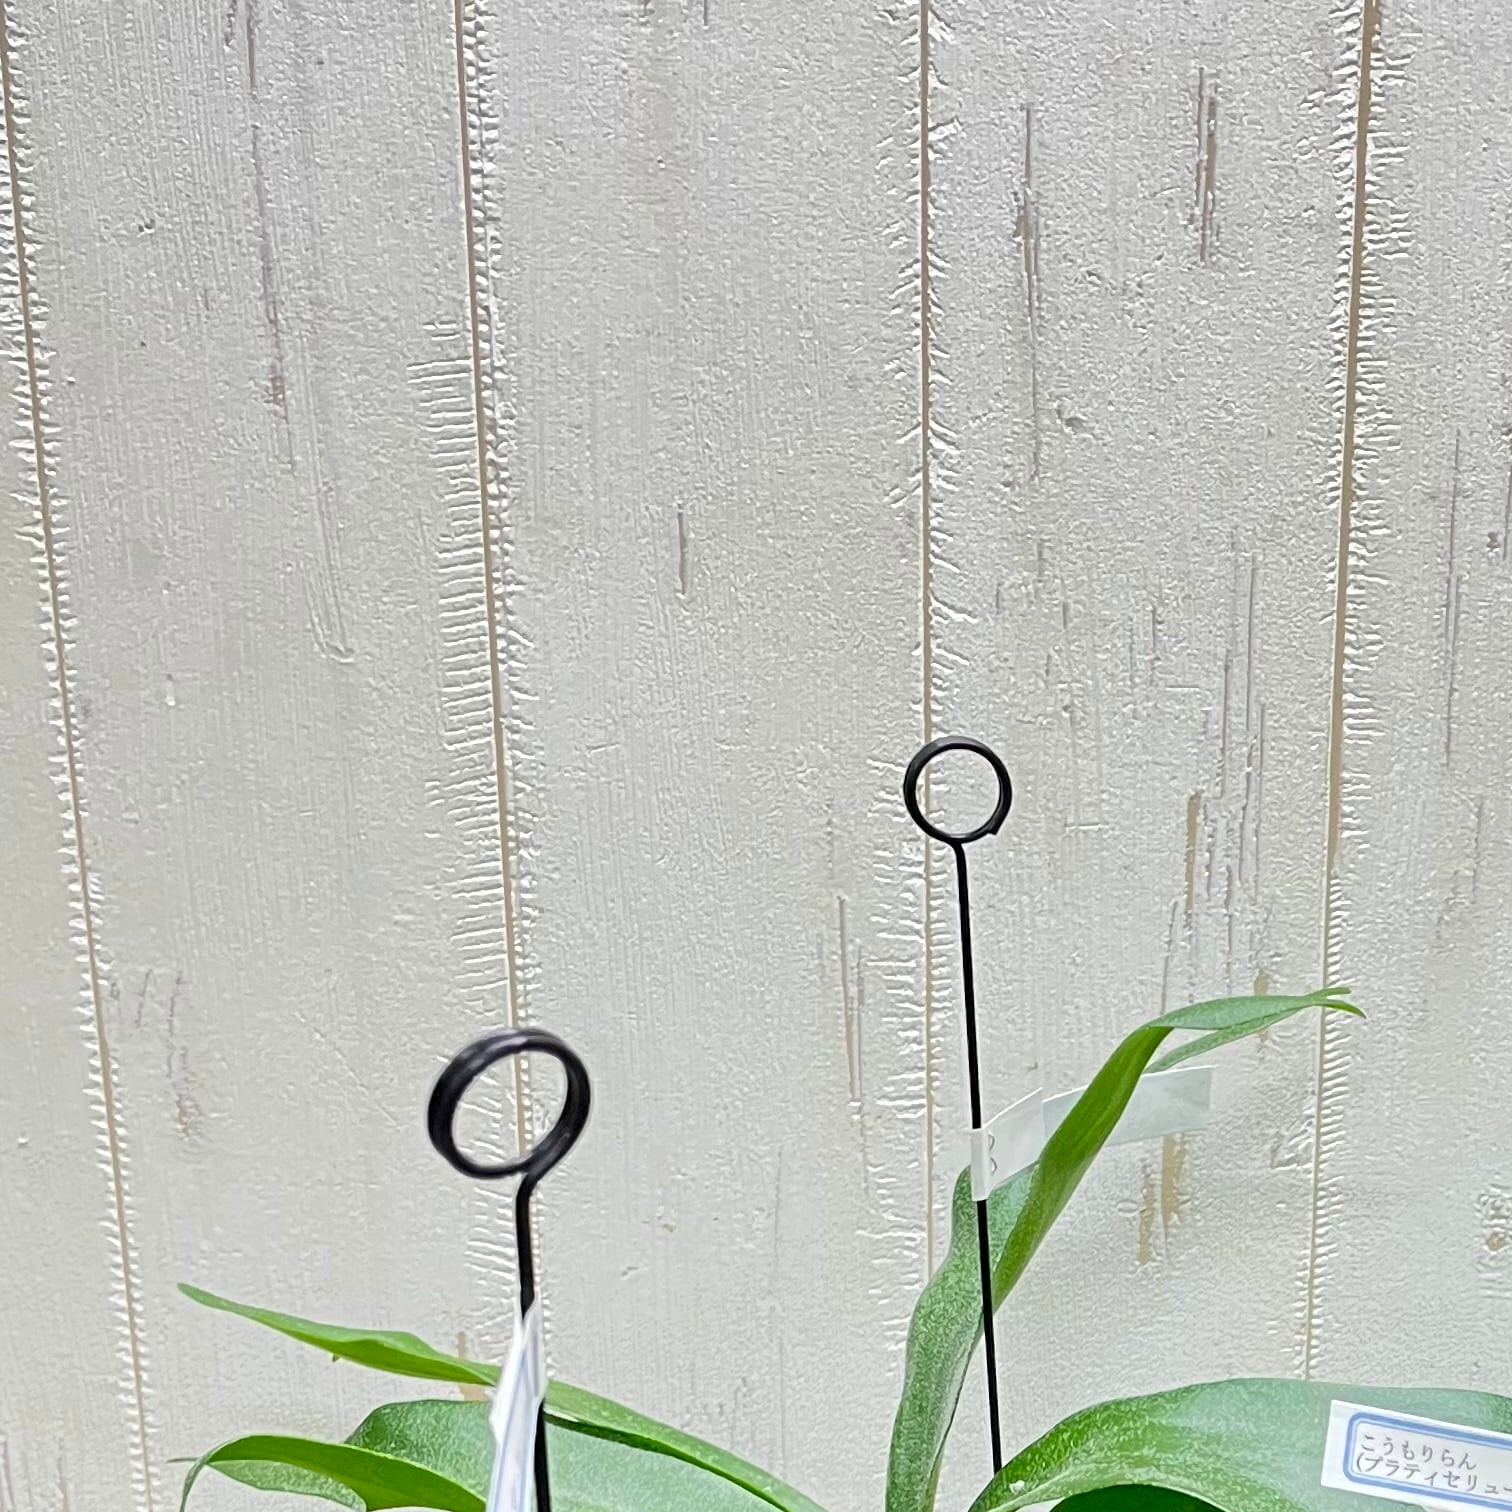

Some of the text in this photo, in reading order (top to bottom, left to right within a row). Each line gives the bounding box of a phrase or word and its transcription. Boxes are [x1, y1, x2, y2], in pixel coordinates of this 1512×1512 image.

[1360, 1433, 1478, 1470] こうもりらん
